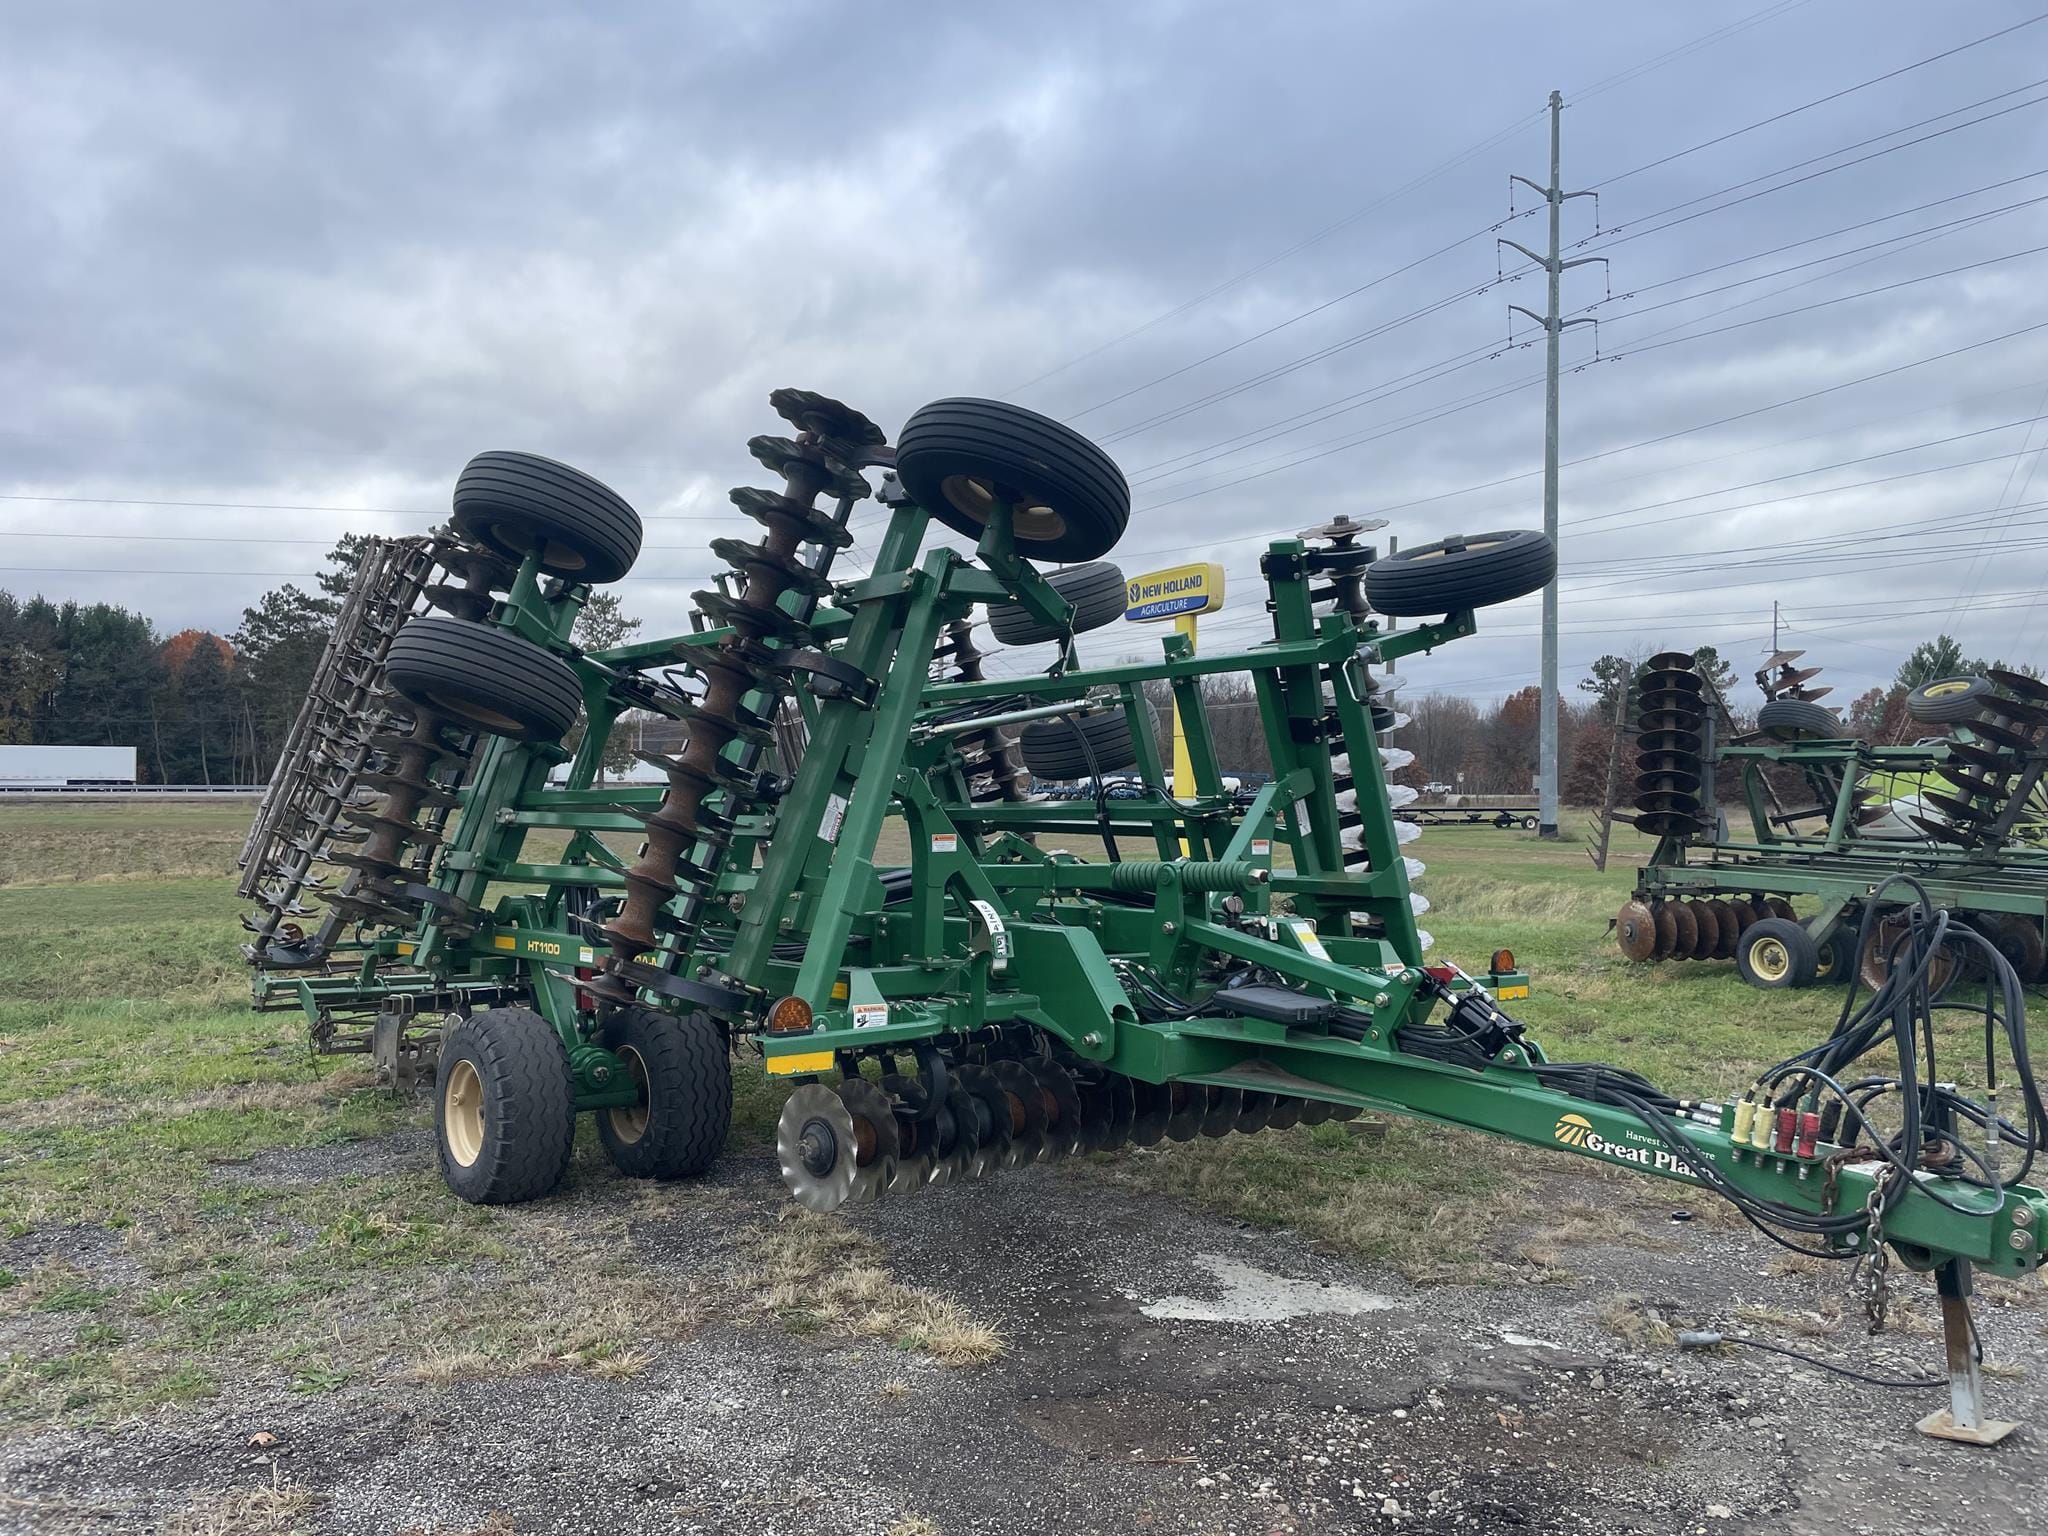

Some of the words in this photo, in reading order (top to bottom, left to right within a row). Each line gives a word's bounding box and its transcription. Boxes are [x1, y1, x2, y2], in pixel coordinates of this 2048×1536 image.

[1142, 583, 1161, 598] NEW
[1163, 575, 1202, 594] HOLLAND
[1141, 599, 1188, 616] AGRICULTURE
[527, 940, 560, 955] HT1100
[1625, 1130, 1660, 1146] Harvest
[1585, 1132, 1650, 1165] Great
